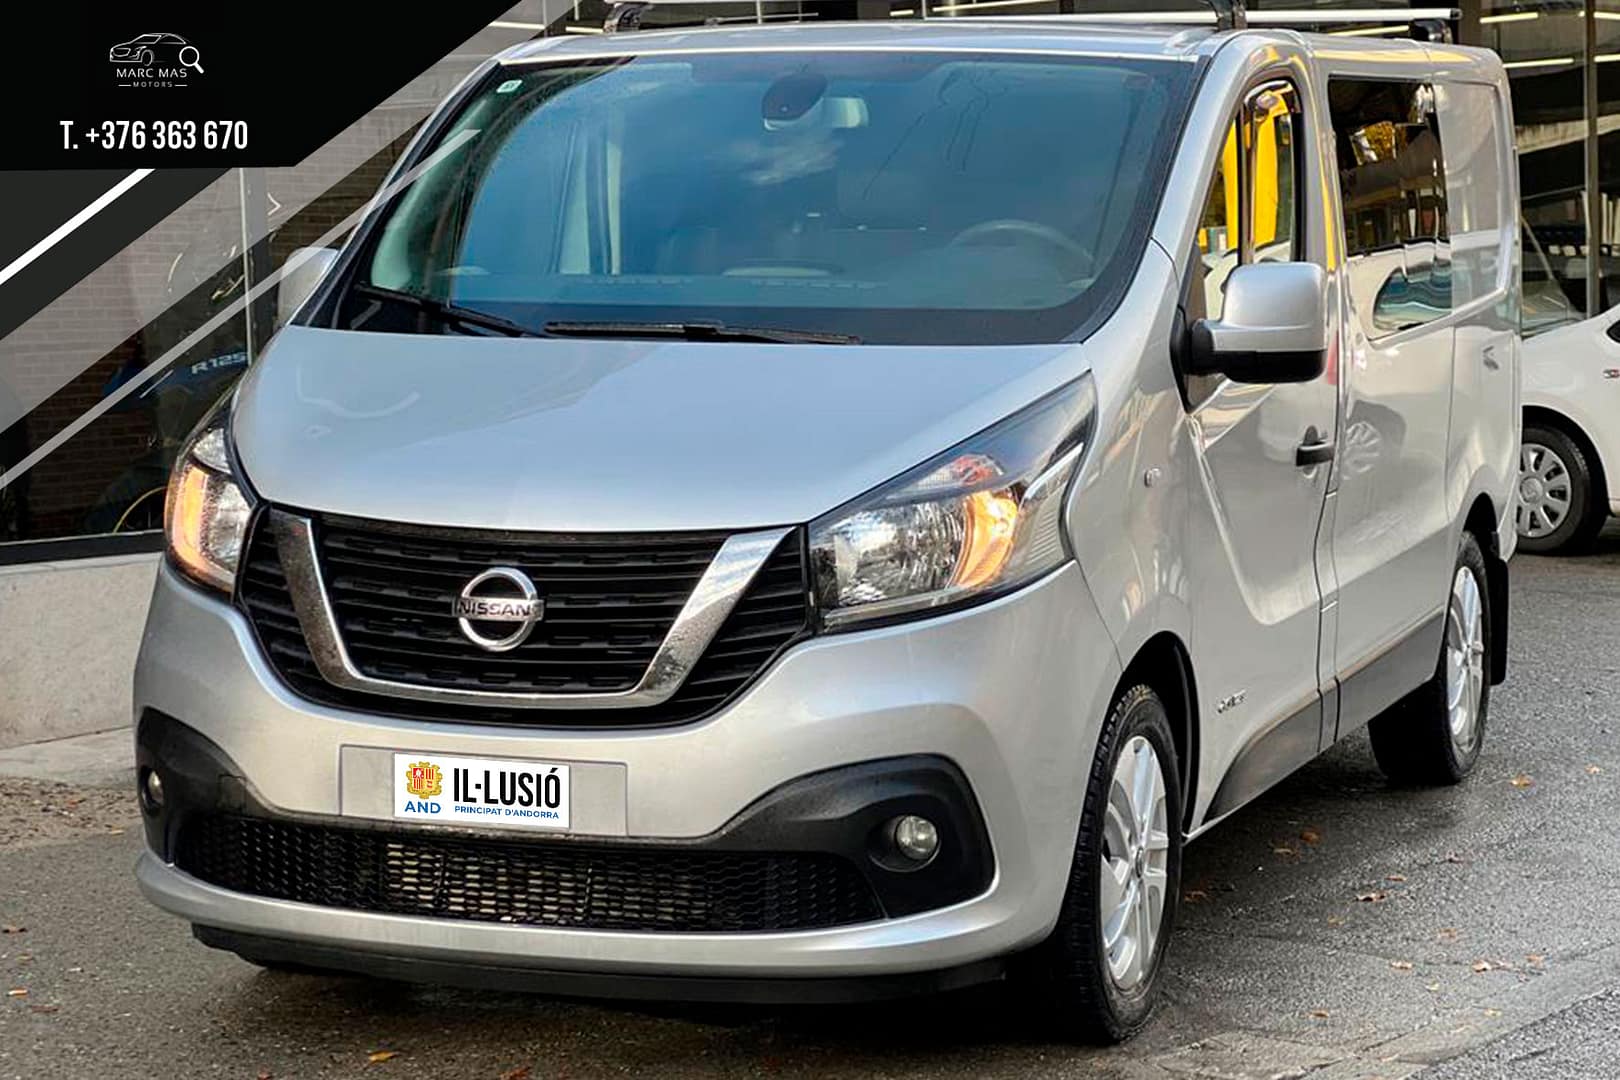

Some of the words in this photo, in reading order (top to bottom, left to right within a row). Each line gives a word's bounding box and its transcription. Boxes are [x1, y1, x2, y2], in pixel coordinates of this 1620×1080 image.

[459, 601, 531, 617] NISSAN
[404, 800, 442, 814] AND
[454, 805, 503, 816] PRINCIPAT
[505, 808, 559, 819] D'ANDORRA
